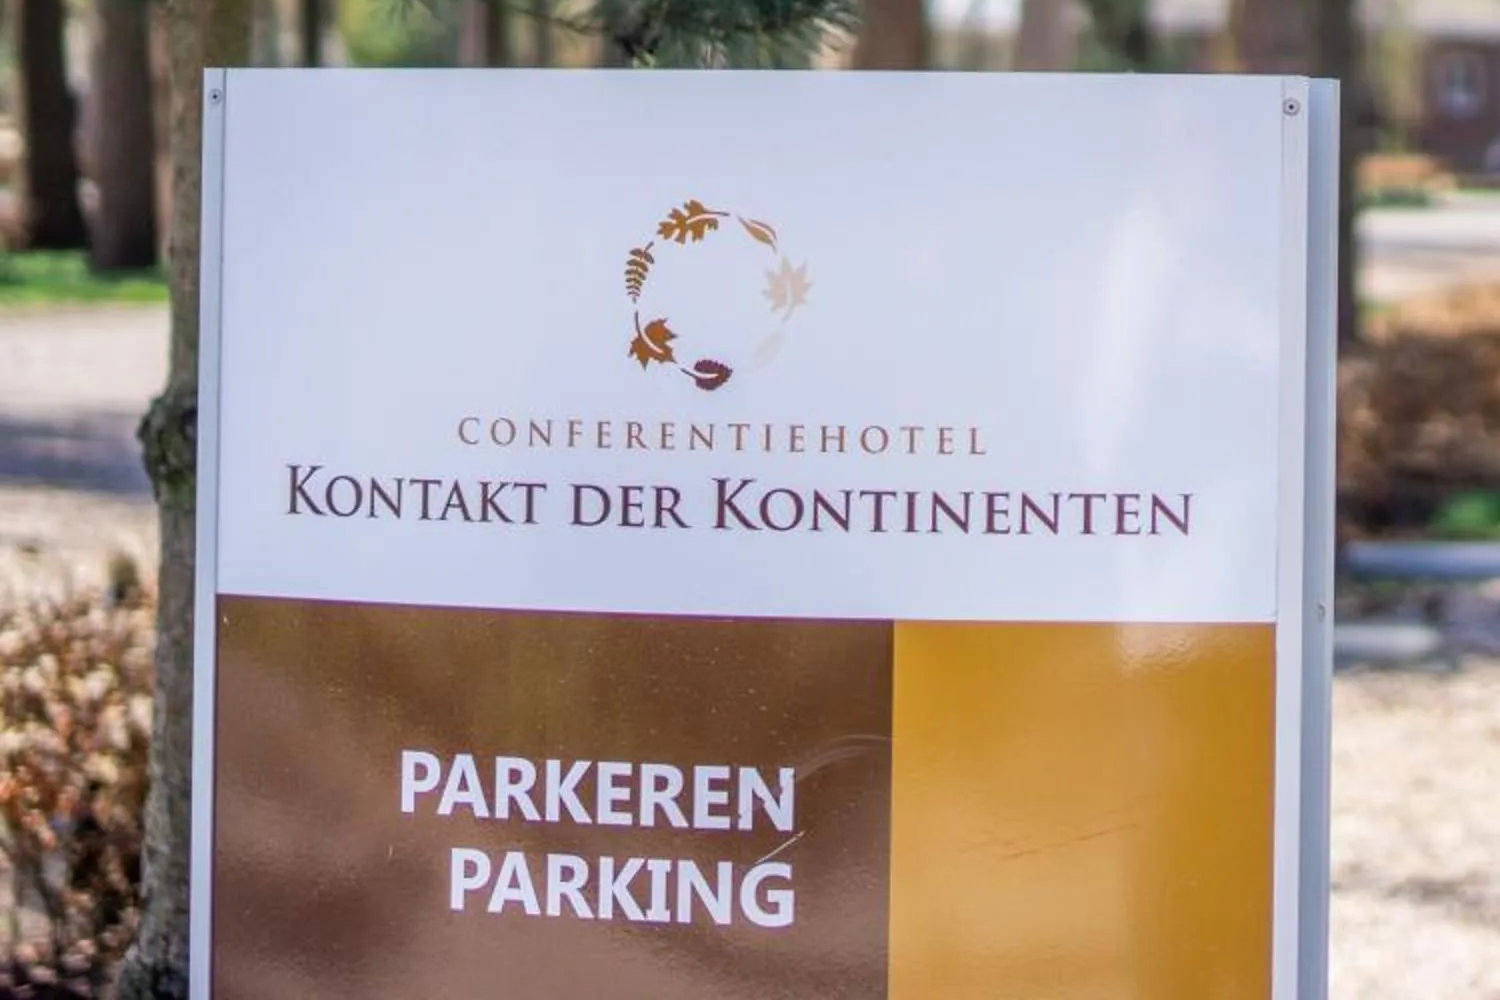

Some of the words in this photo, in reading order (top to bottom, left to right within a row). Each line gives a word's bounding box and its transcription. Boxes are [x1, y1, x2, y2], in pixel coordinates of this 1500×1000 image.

[457, 415, 988, 457] CONFERENTIEHOTEL
[287, 465, 548, 525] KONTAKT
[571, 483, 691, 529] DER
[711, 477, 1192, 536] KONTINENTEN
[400, 749, 795, 832] PARKEREN
[449, 846, 795, 928] PARKING
